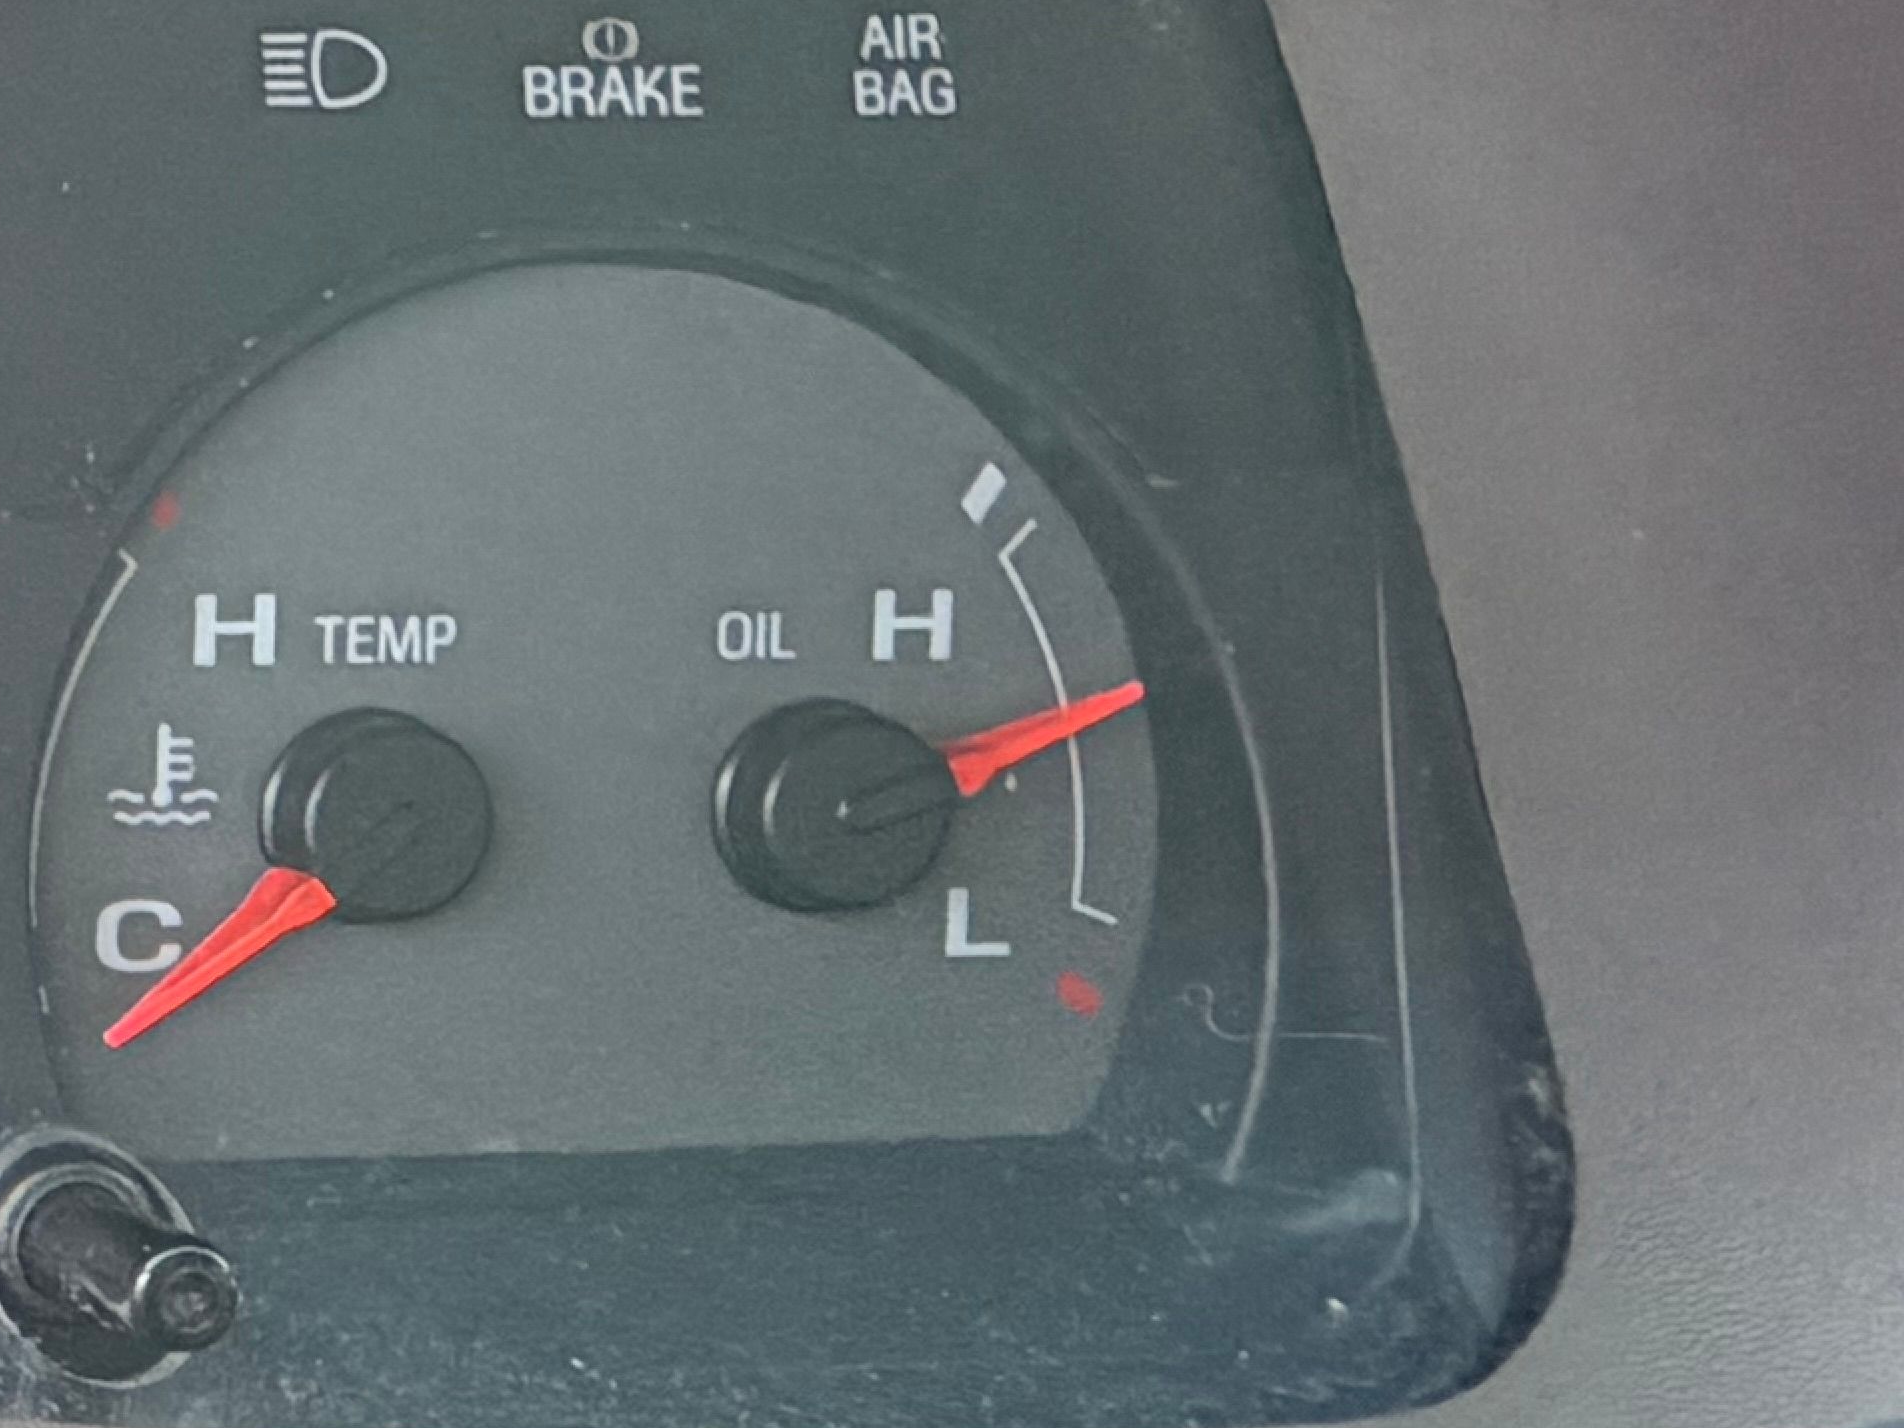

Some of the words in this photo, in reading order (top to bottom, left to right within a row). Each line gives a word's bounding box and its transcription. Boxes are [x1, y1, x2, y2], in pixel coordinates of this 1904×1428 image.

[860, 13, 941, 60] AIR
[523, 63, 703, 118] BRAKE
[853, 67, 956, 116] BAG
[193, 593, 276, 667] H
[313, 614, 457, 664] TEMP
[717, 611, 796, 661] OIL
[872, 588, 954, 661] H
[95, 898, 183, 973] C
[944, 888, 1011, 957] L
